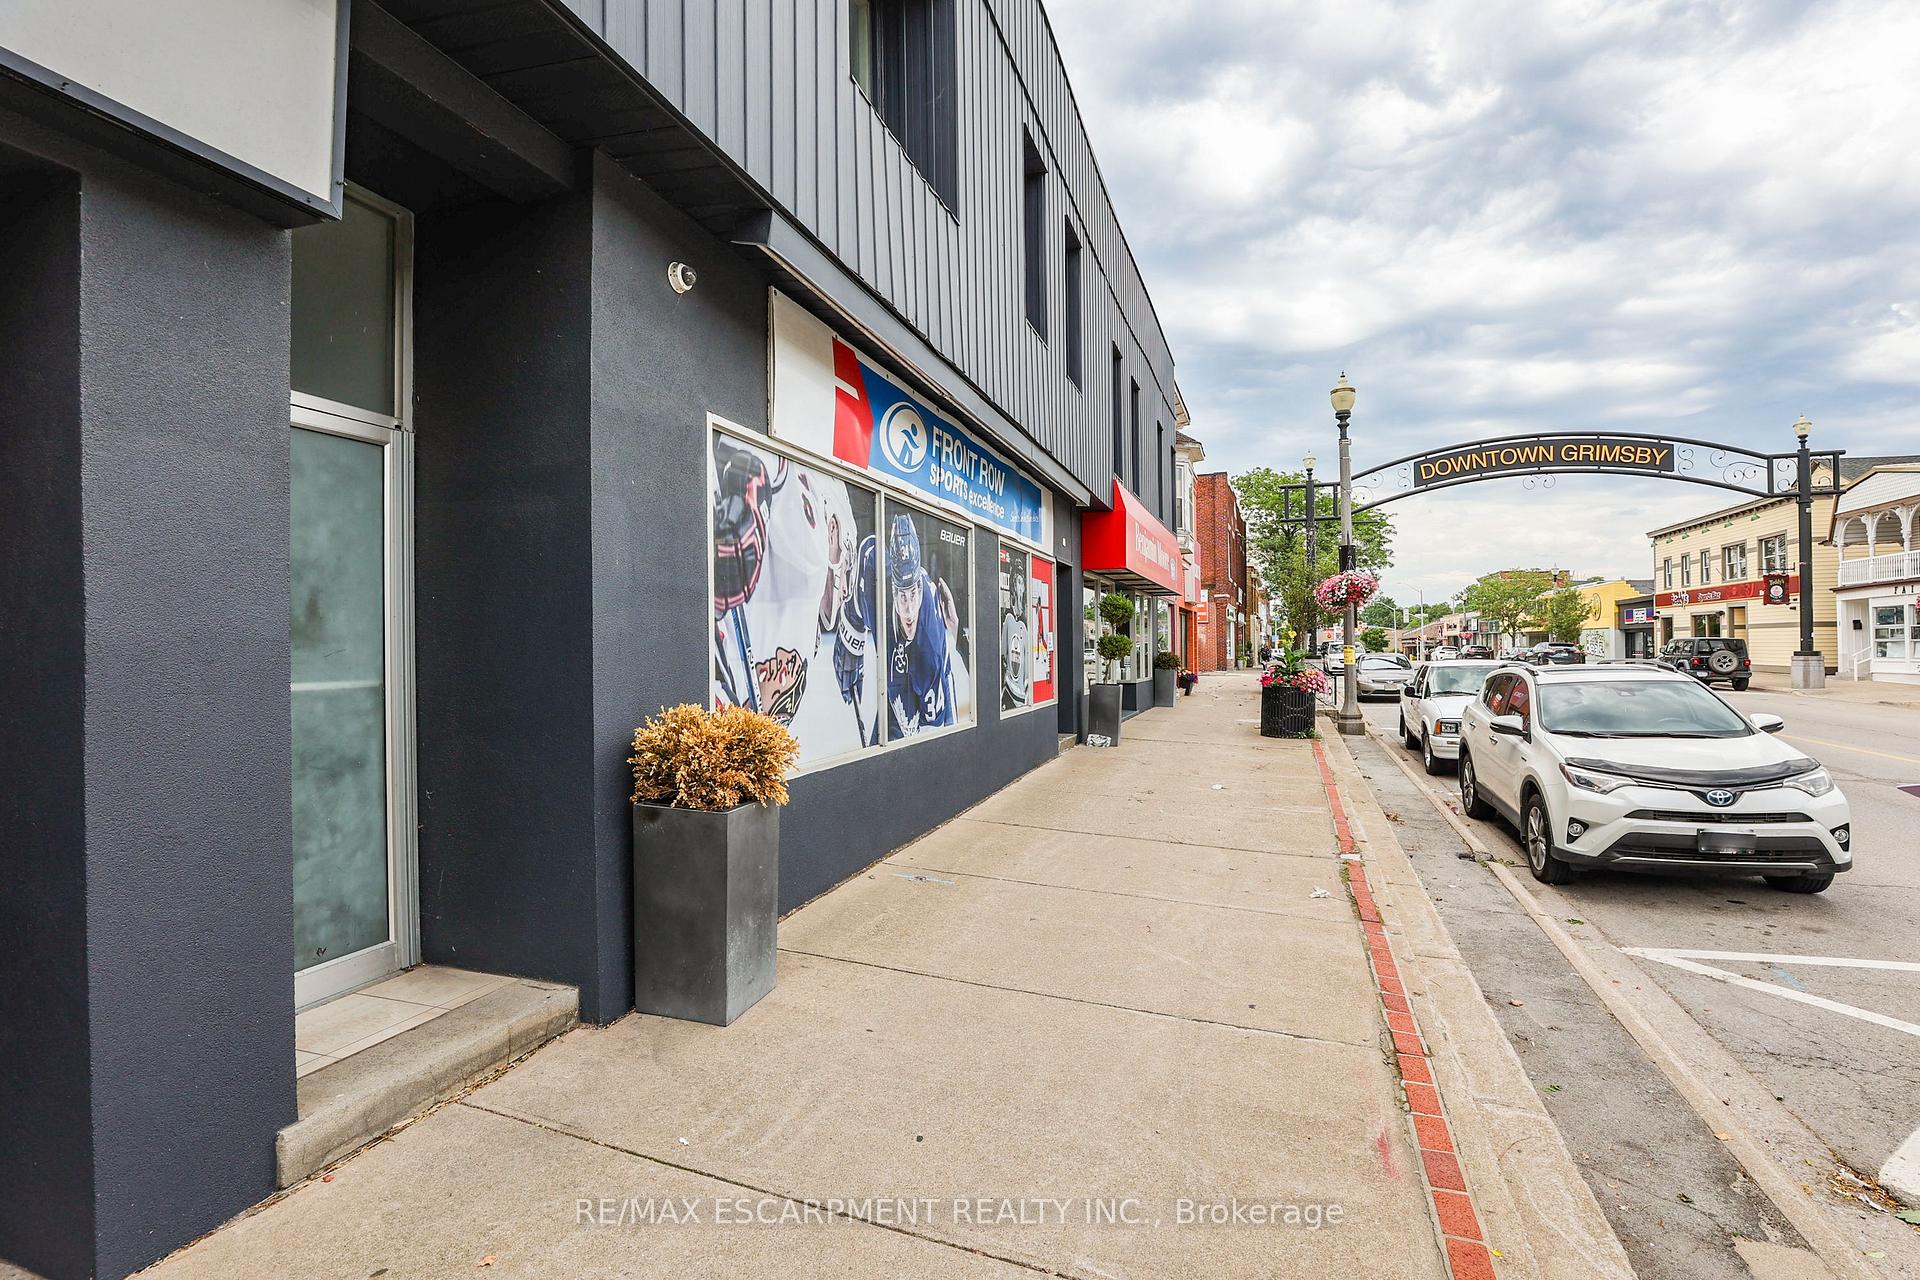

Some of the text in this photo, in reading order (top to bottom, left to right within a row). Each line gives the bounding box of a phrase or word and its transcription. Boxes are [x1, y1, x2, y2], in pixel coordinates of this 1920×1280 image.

[932, 426, 1006, 496] FRONT ROW
[1419, 443, 1669, 480] DOWNTOWN GRIMSBY
[930, 463, 1005, 519] SPORTS excellence
[940, 529, 965, 547] BAUER
[923, 681, 945, 722] 34
